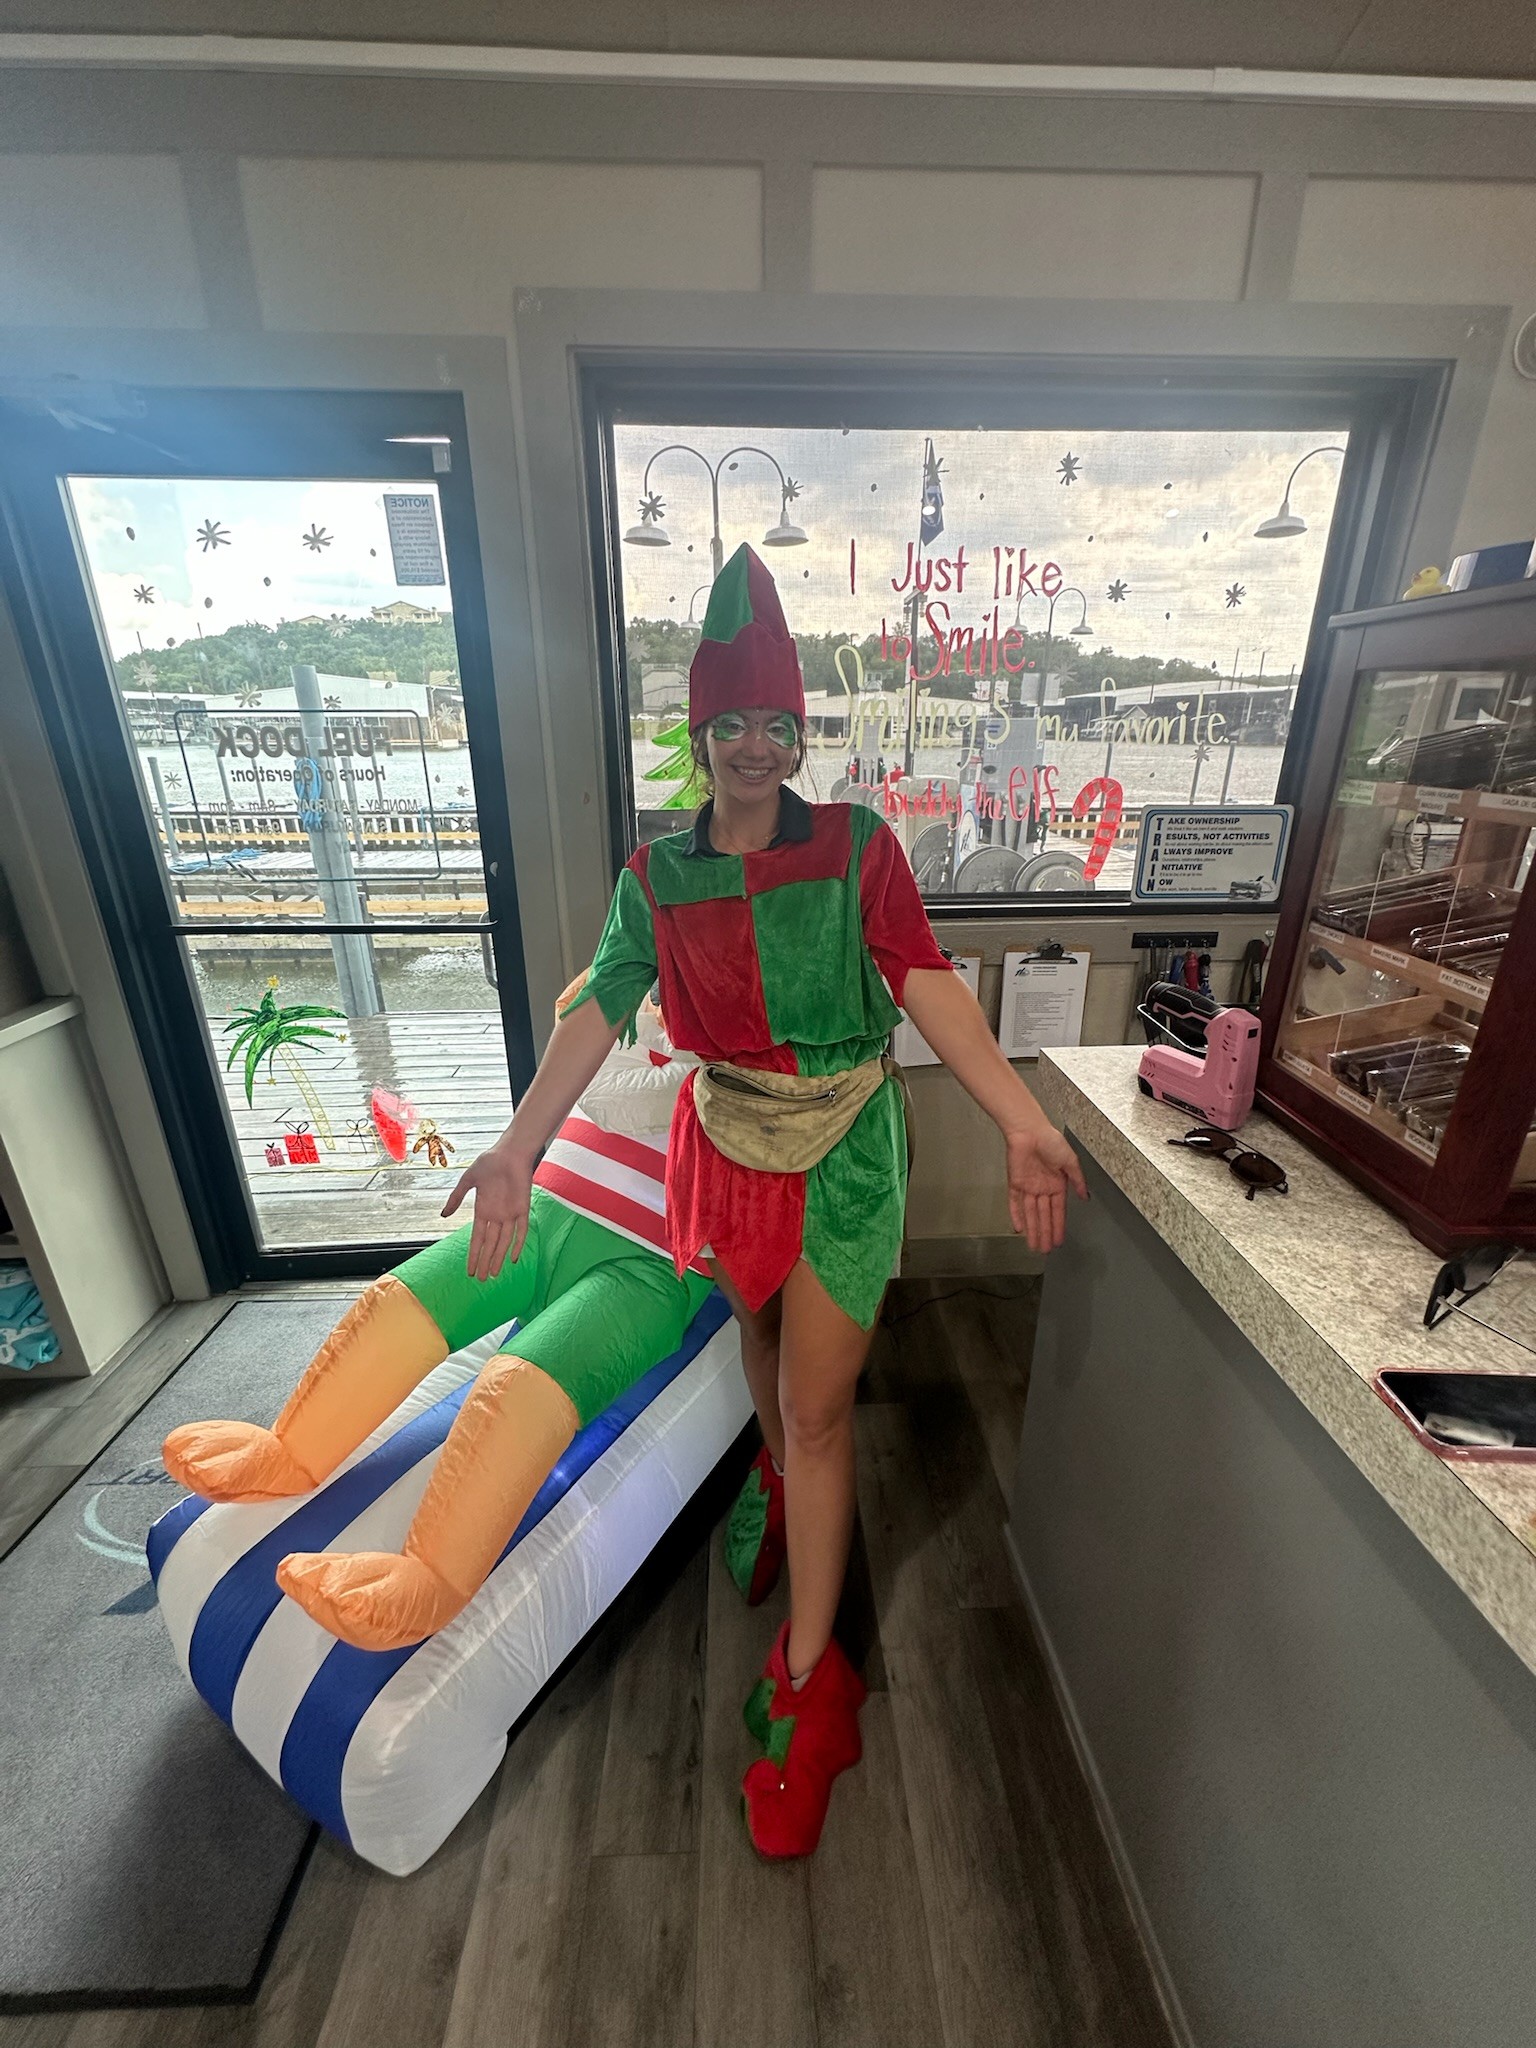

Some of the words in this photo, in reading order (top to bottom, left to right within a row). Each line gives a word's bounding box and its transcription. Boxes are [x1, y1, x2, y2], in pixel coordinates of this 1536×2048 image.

[849, 538, 855, 595] I
[891, 542, 969, 594] Just
[993, 547, 1063, 600] like
[881, 618, 911, 661] to
[1188, 817, 1240, 825] OWNERSHIP
